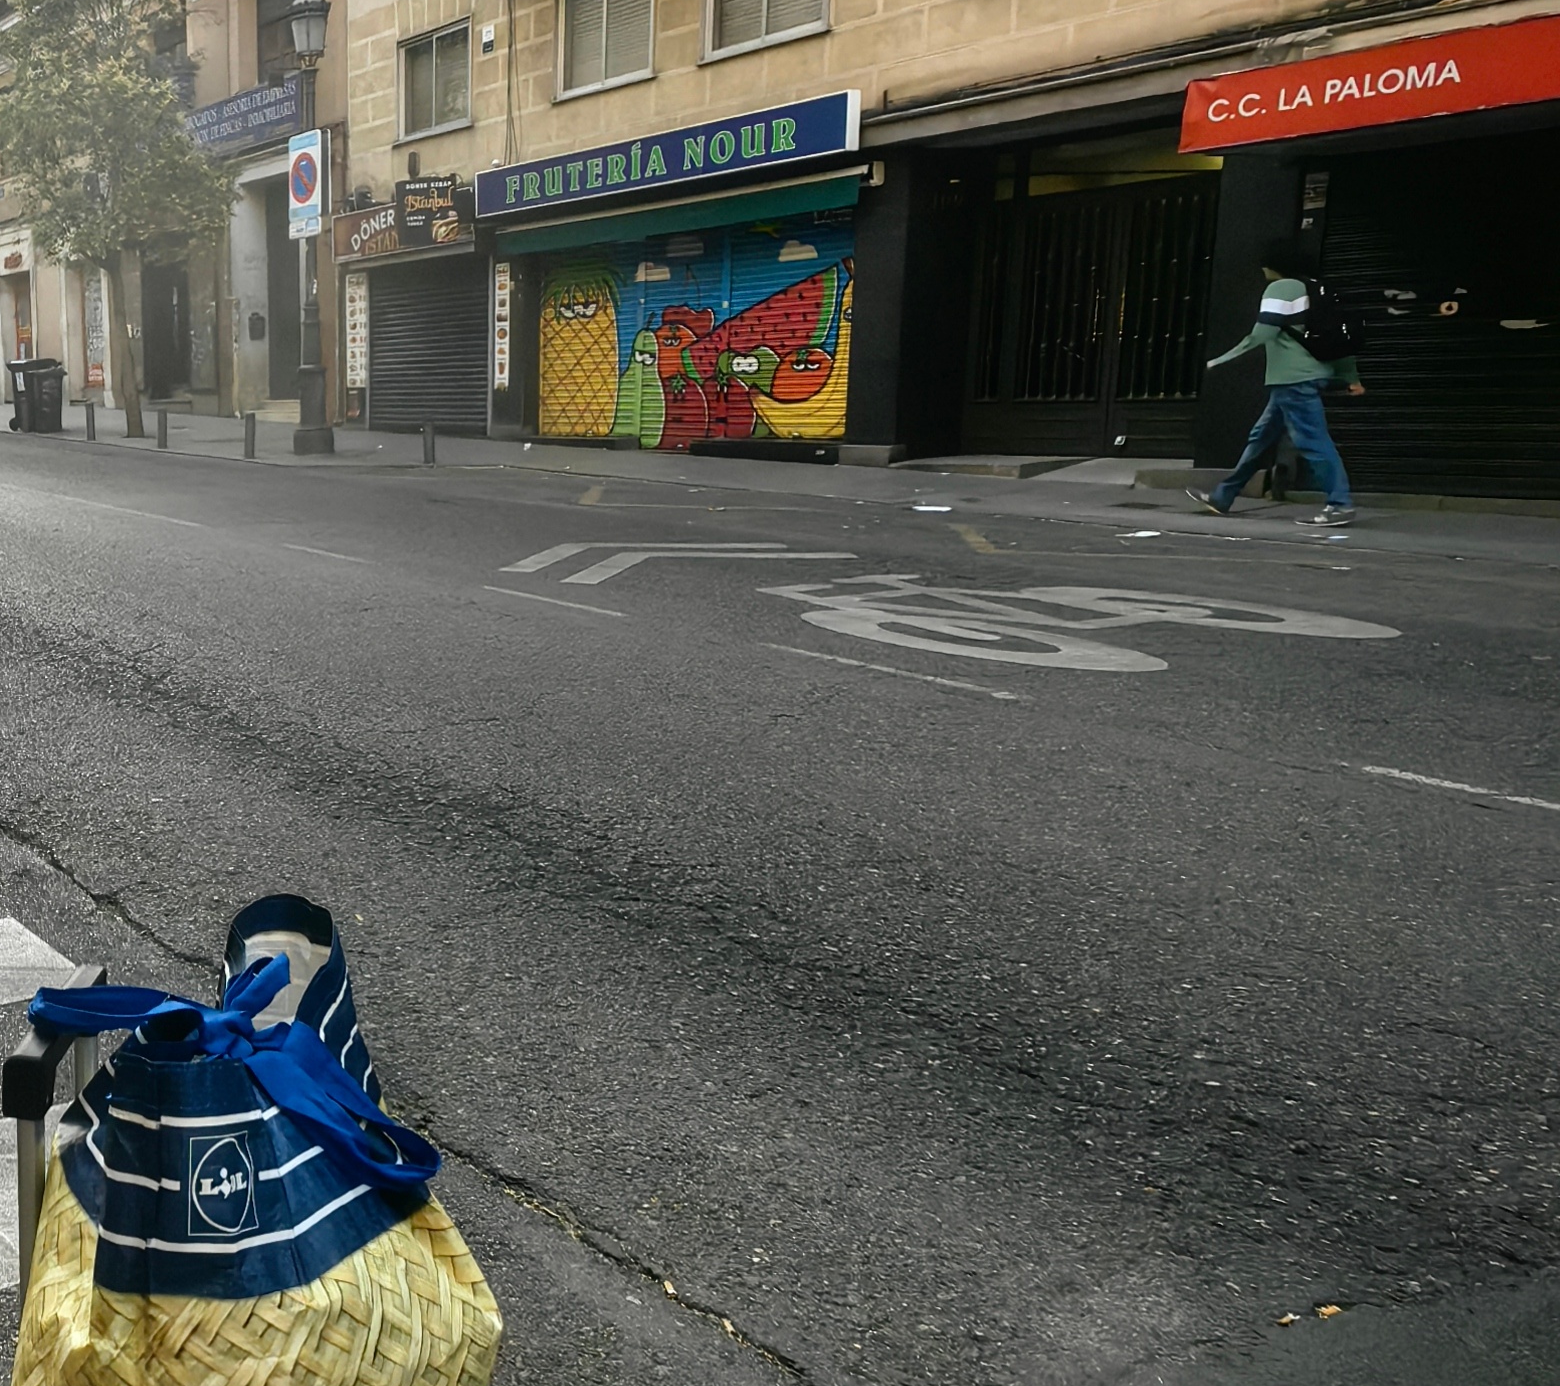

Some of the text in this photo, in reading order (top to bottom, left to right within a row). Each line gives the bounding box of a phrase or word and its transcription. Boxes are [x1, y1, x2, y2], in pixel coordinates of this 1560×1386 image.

[1207, 59, 1461, 123] C.C. LA PALOMA
[505, 118, 796, 204] FRUTERÍA NOUR
[351, 209, 395, 251] DÖNER
